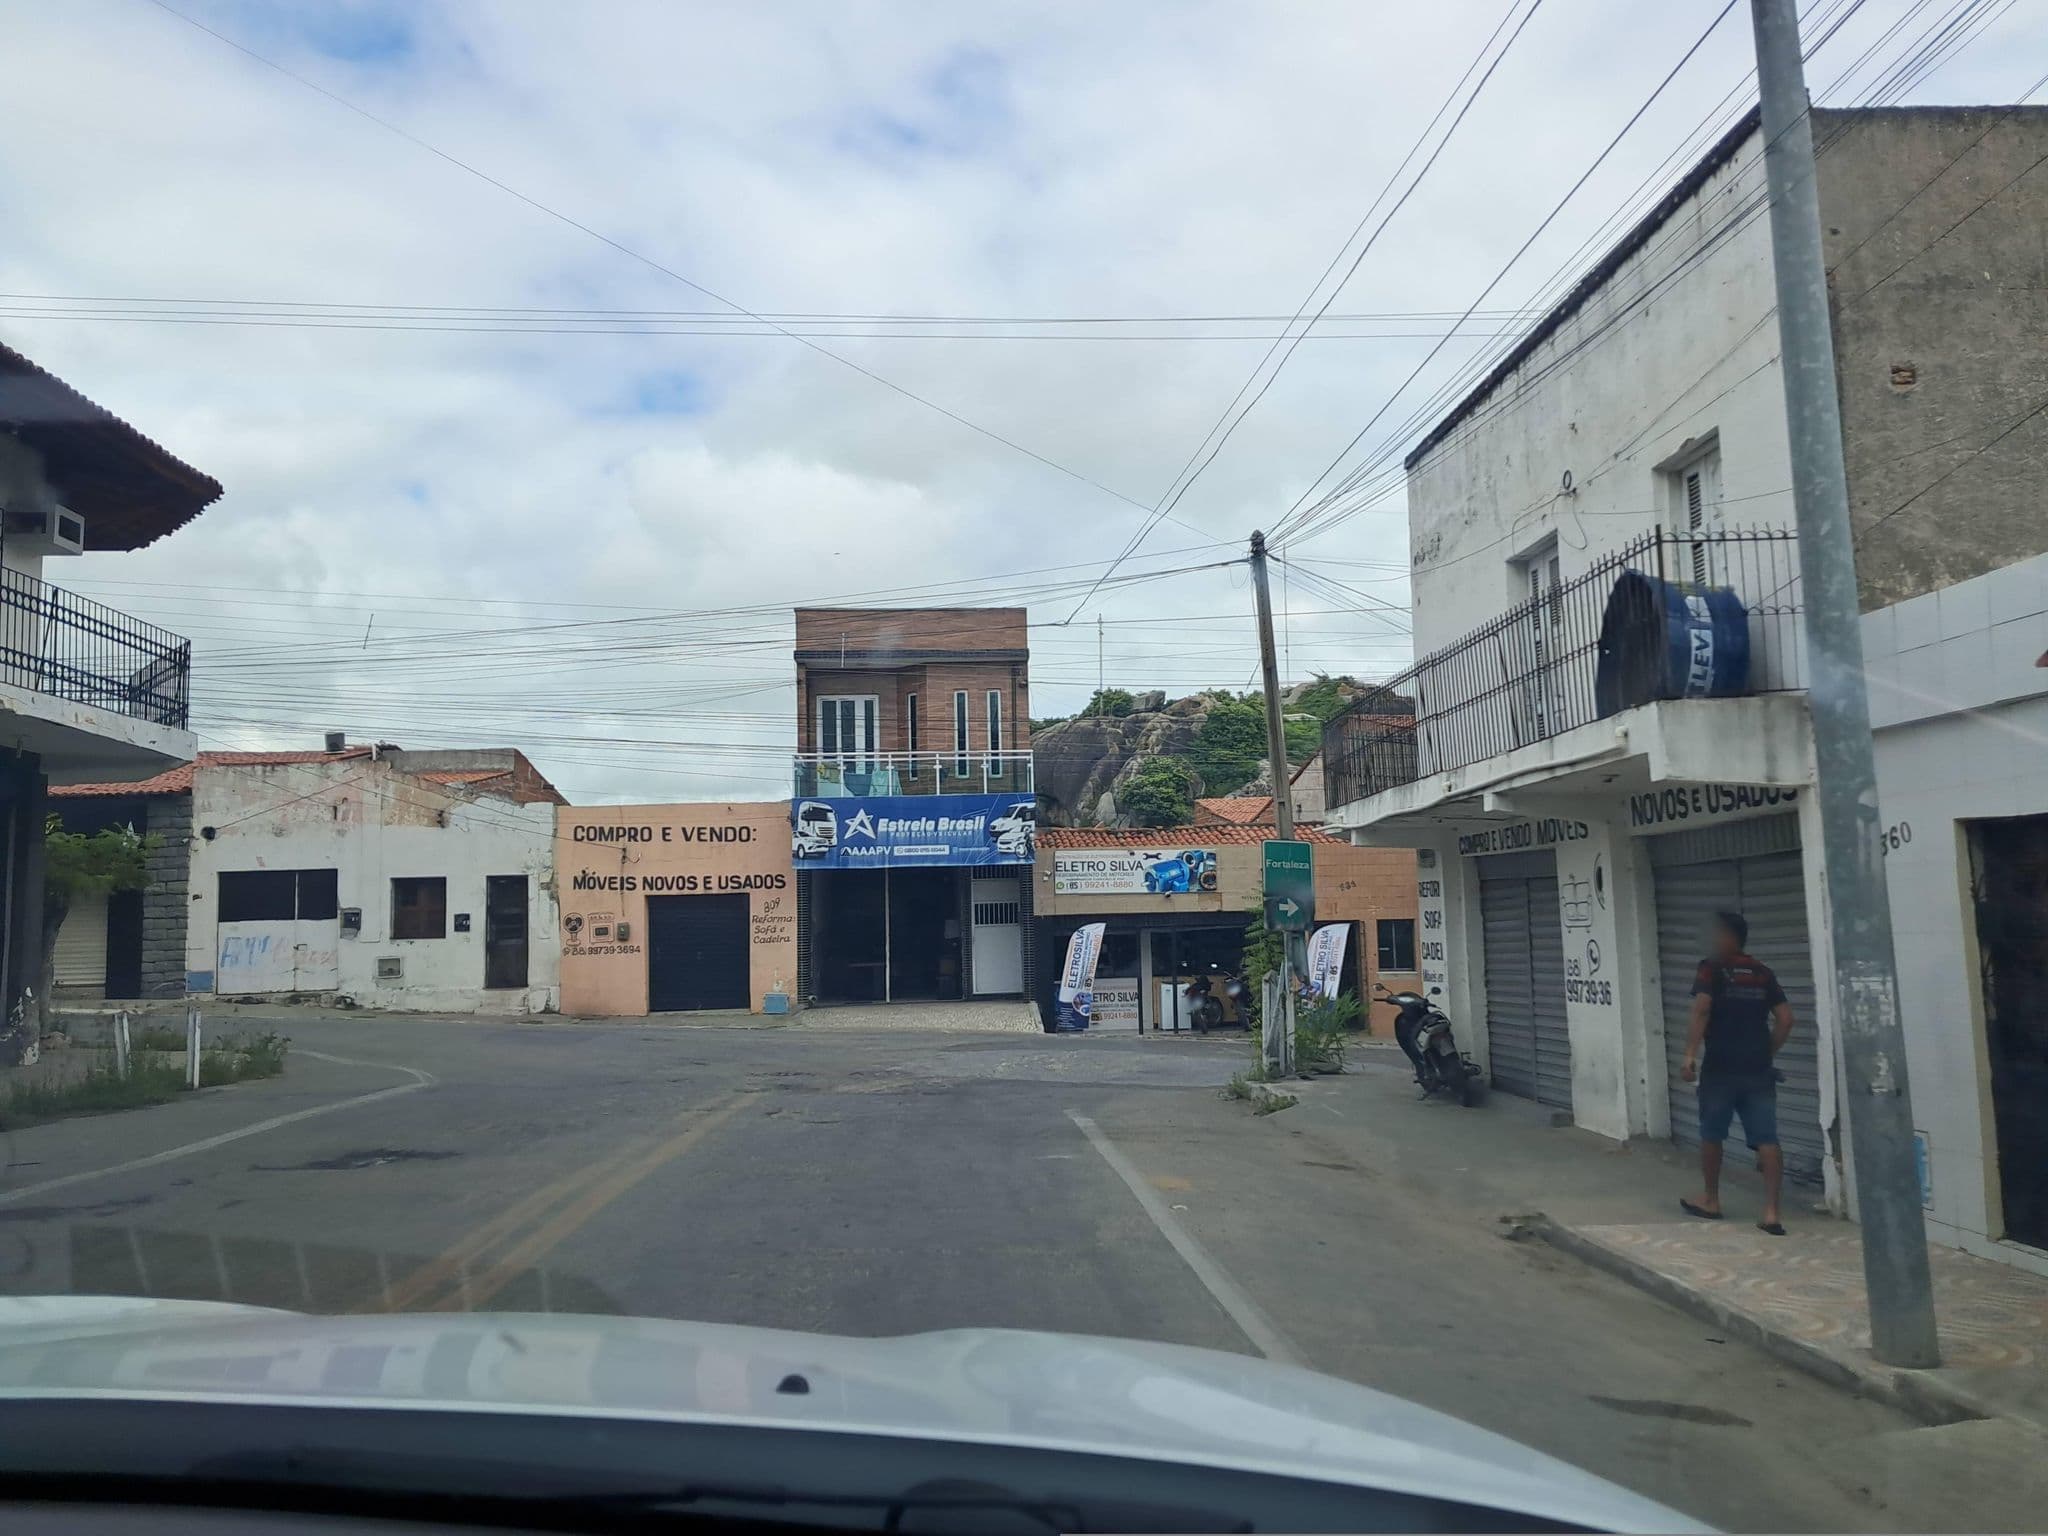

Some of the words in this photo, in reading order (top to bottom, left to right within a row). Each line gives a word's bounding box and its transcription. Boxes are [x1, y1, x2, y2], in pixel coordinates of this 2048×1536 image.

[1630, 787, 1688, 827] NOVOS
[878, 817, 935, 832] Estrela
[938, 816, 985, 831] Brasil
[573, 825, 653, 843] COMPRO
[661, 826, 673, 842] E
[682, 825, 757, 843] VENDO:
[1459, 832, 1490, 855] COMPRO
[1491, 830, 1497, 851] E
[1498, 822, 1532, 850] VENDO
[1055, 860, 1106, 872] ELETRO
[1110, 860, 1144, 872] SILVA
[1265, 858, 1310, 870] Fortaleza
[573, 872, 637, 891] MÓVEIS
[642, 875, 698, 891] NOVOS
[703, 875, 713, 890] E
[718, 874, 786, 890] USADOS
[753, 934, 791, 944] Cadeira
[1319, 929, 1330, 950] SILVA
[1092, 992, 1116, 1002] ETRO
[1117, 992, 1139, 1002] SILVA
